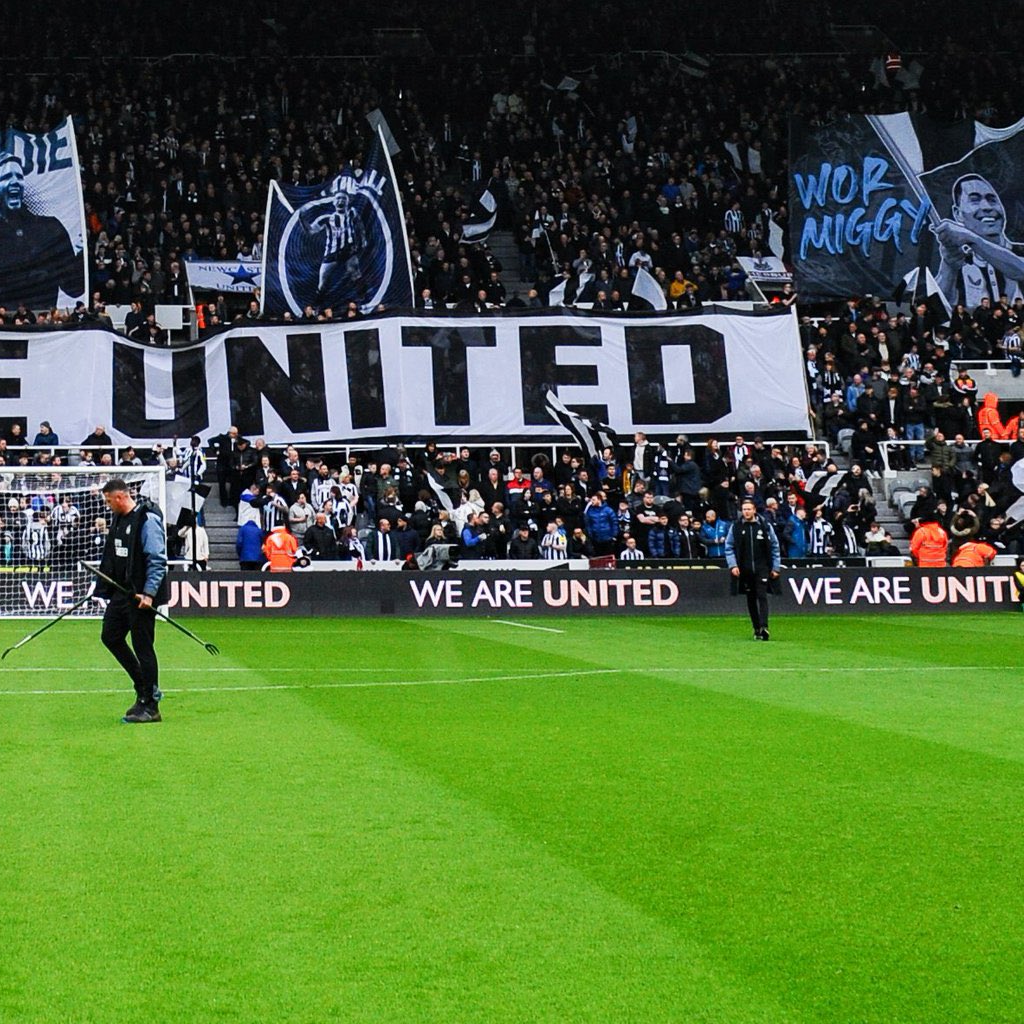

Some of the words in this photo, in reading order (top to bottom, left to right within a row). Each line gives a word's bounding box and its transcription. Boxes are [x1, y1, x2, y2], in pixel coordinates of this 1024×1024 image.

[794, 157, 895, 210] WOR
[800, 195, 931, 260] MIGGY
[112, 324, 733, 438] UNITED
[22, 580, 74, 609] WE
[410, 580, 464, 608] WE
[471, 579, 533, 608] ARE
[543, 578, 679, 607] UNITED
[788, 577, 843, 605] WE
[849, 576, 912, 604] ARE
